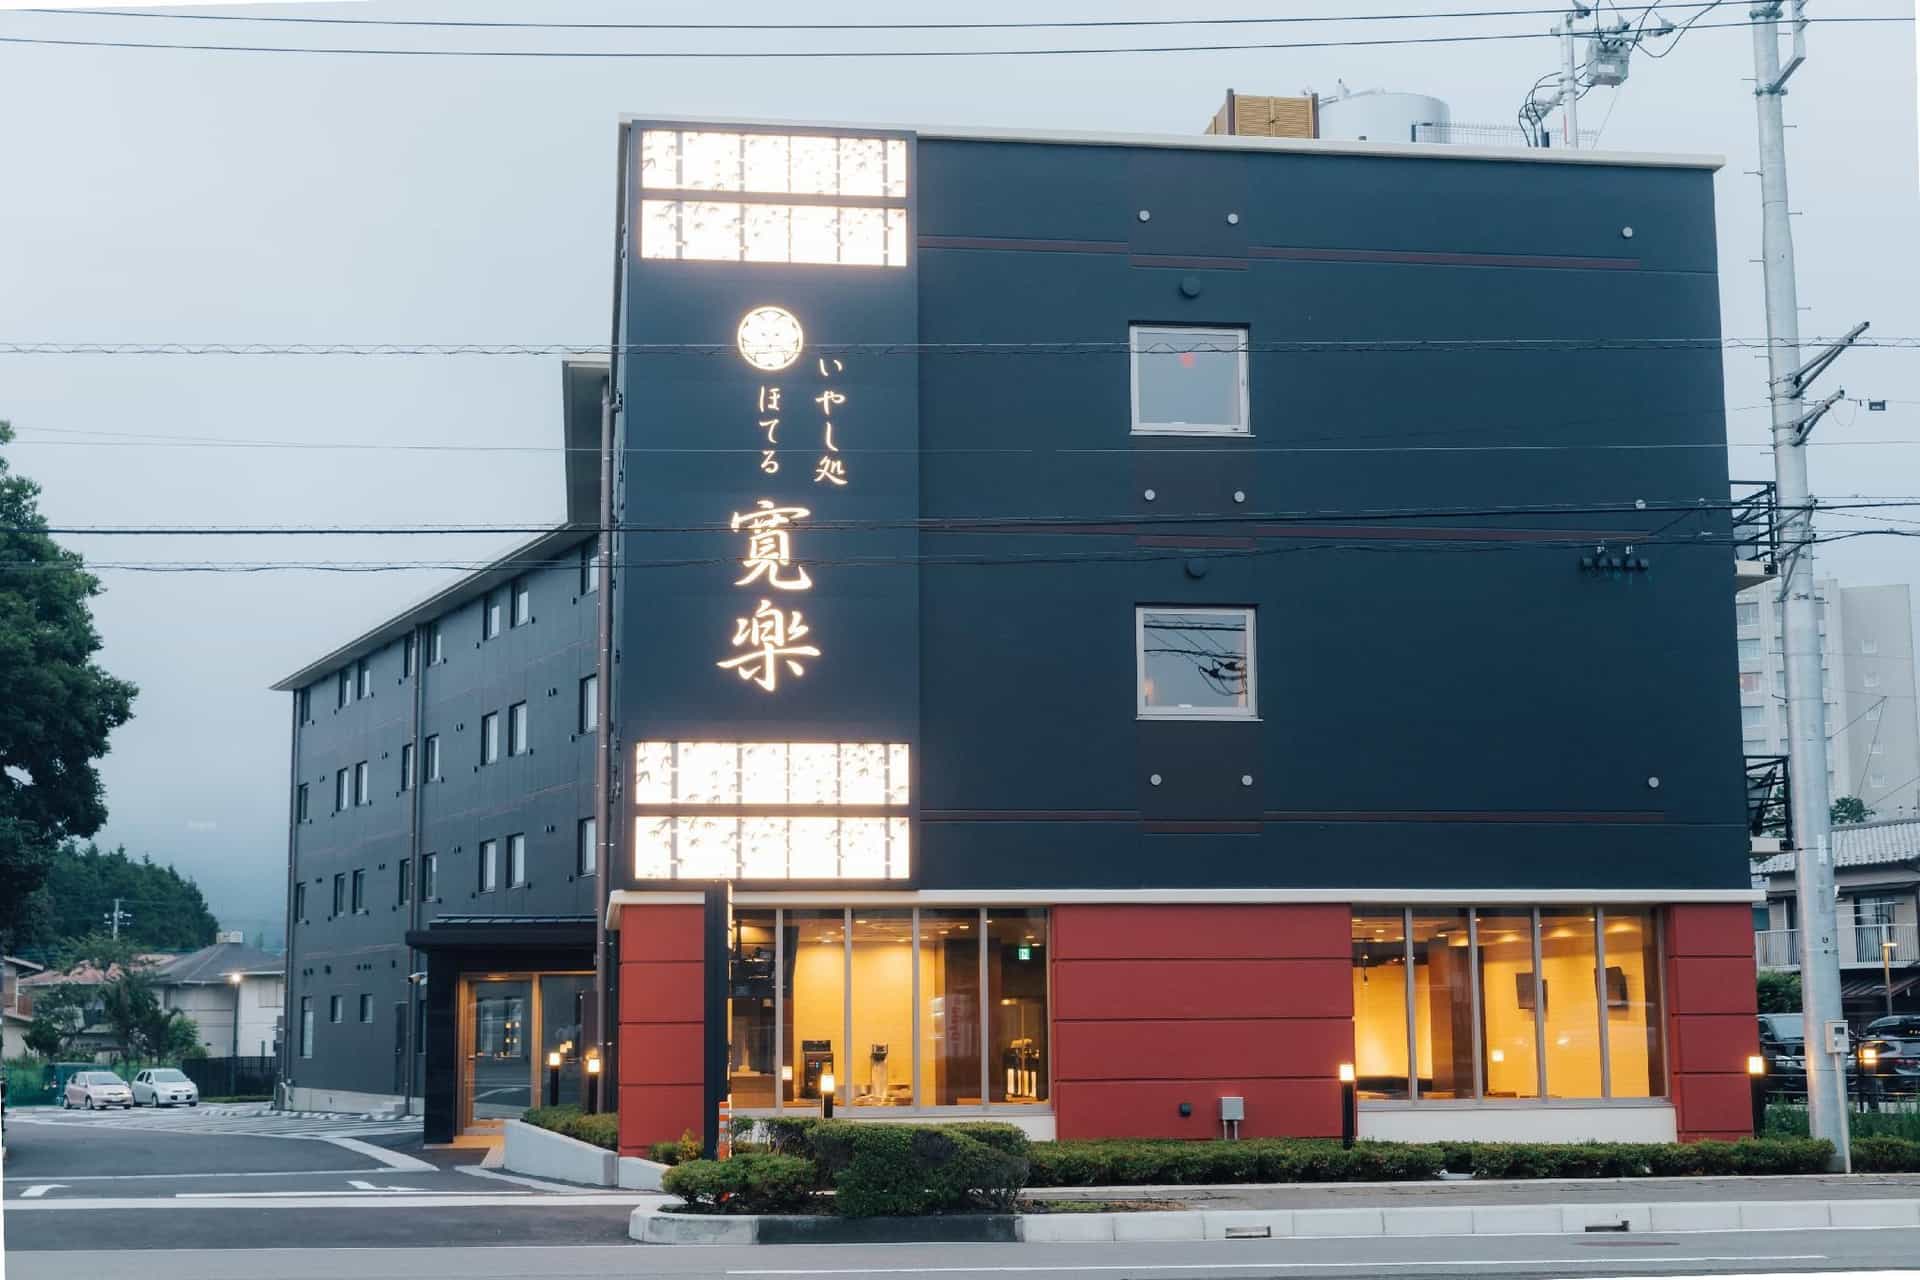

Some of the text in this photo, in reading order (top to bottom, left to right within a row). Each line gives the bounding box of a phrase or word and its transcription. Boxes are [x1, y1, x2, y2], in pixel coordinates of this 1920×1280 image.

[758, 385, 782, 474] ほてる
[813, 357, 848, 486] いやし処
